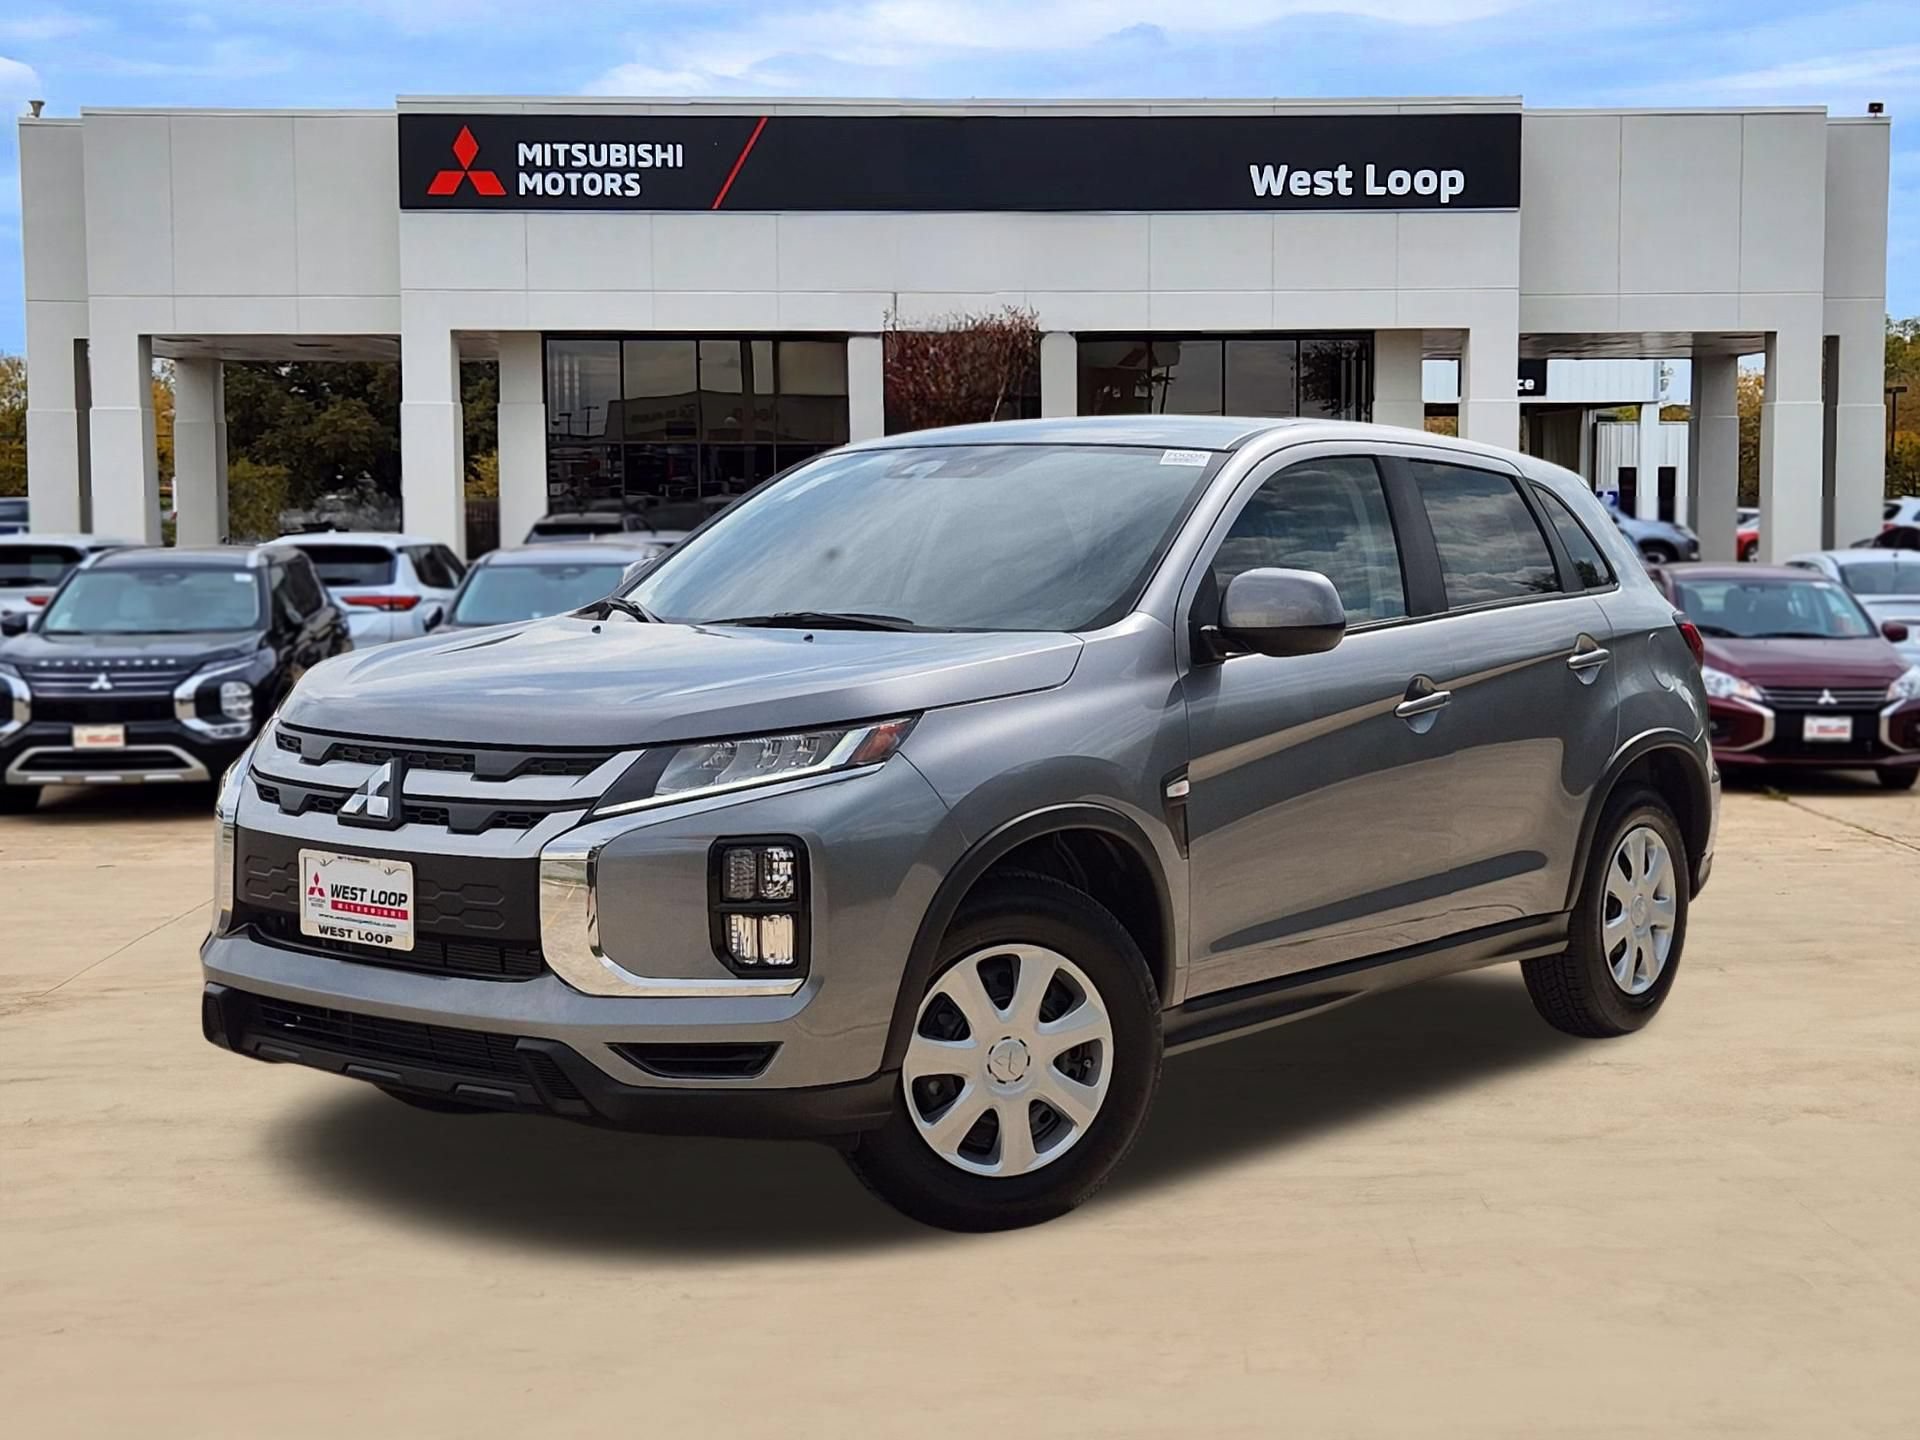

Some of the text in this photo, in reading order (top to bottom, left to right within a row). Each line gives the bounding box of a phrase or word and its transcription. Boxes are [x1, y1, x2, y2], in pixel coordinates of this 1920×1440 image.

[517, 142, 684, 168] MITSUBISHI
[517, 172, 641, 197] MOTORS
[1249, 163, 1465, 204] West Loop
[330, 883, 367, 902] WEST
[370, 889, 408, 907] LOOP
[318, 924, 393, 944] WEST LOOP
